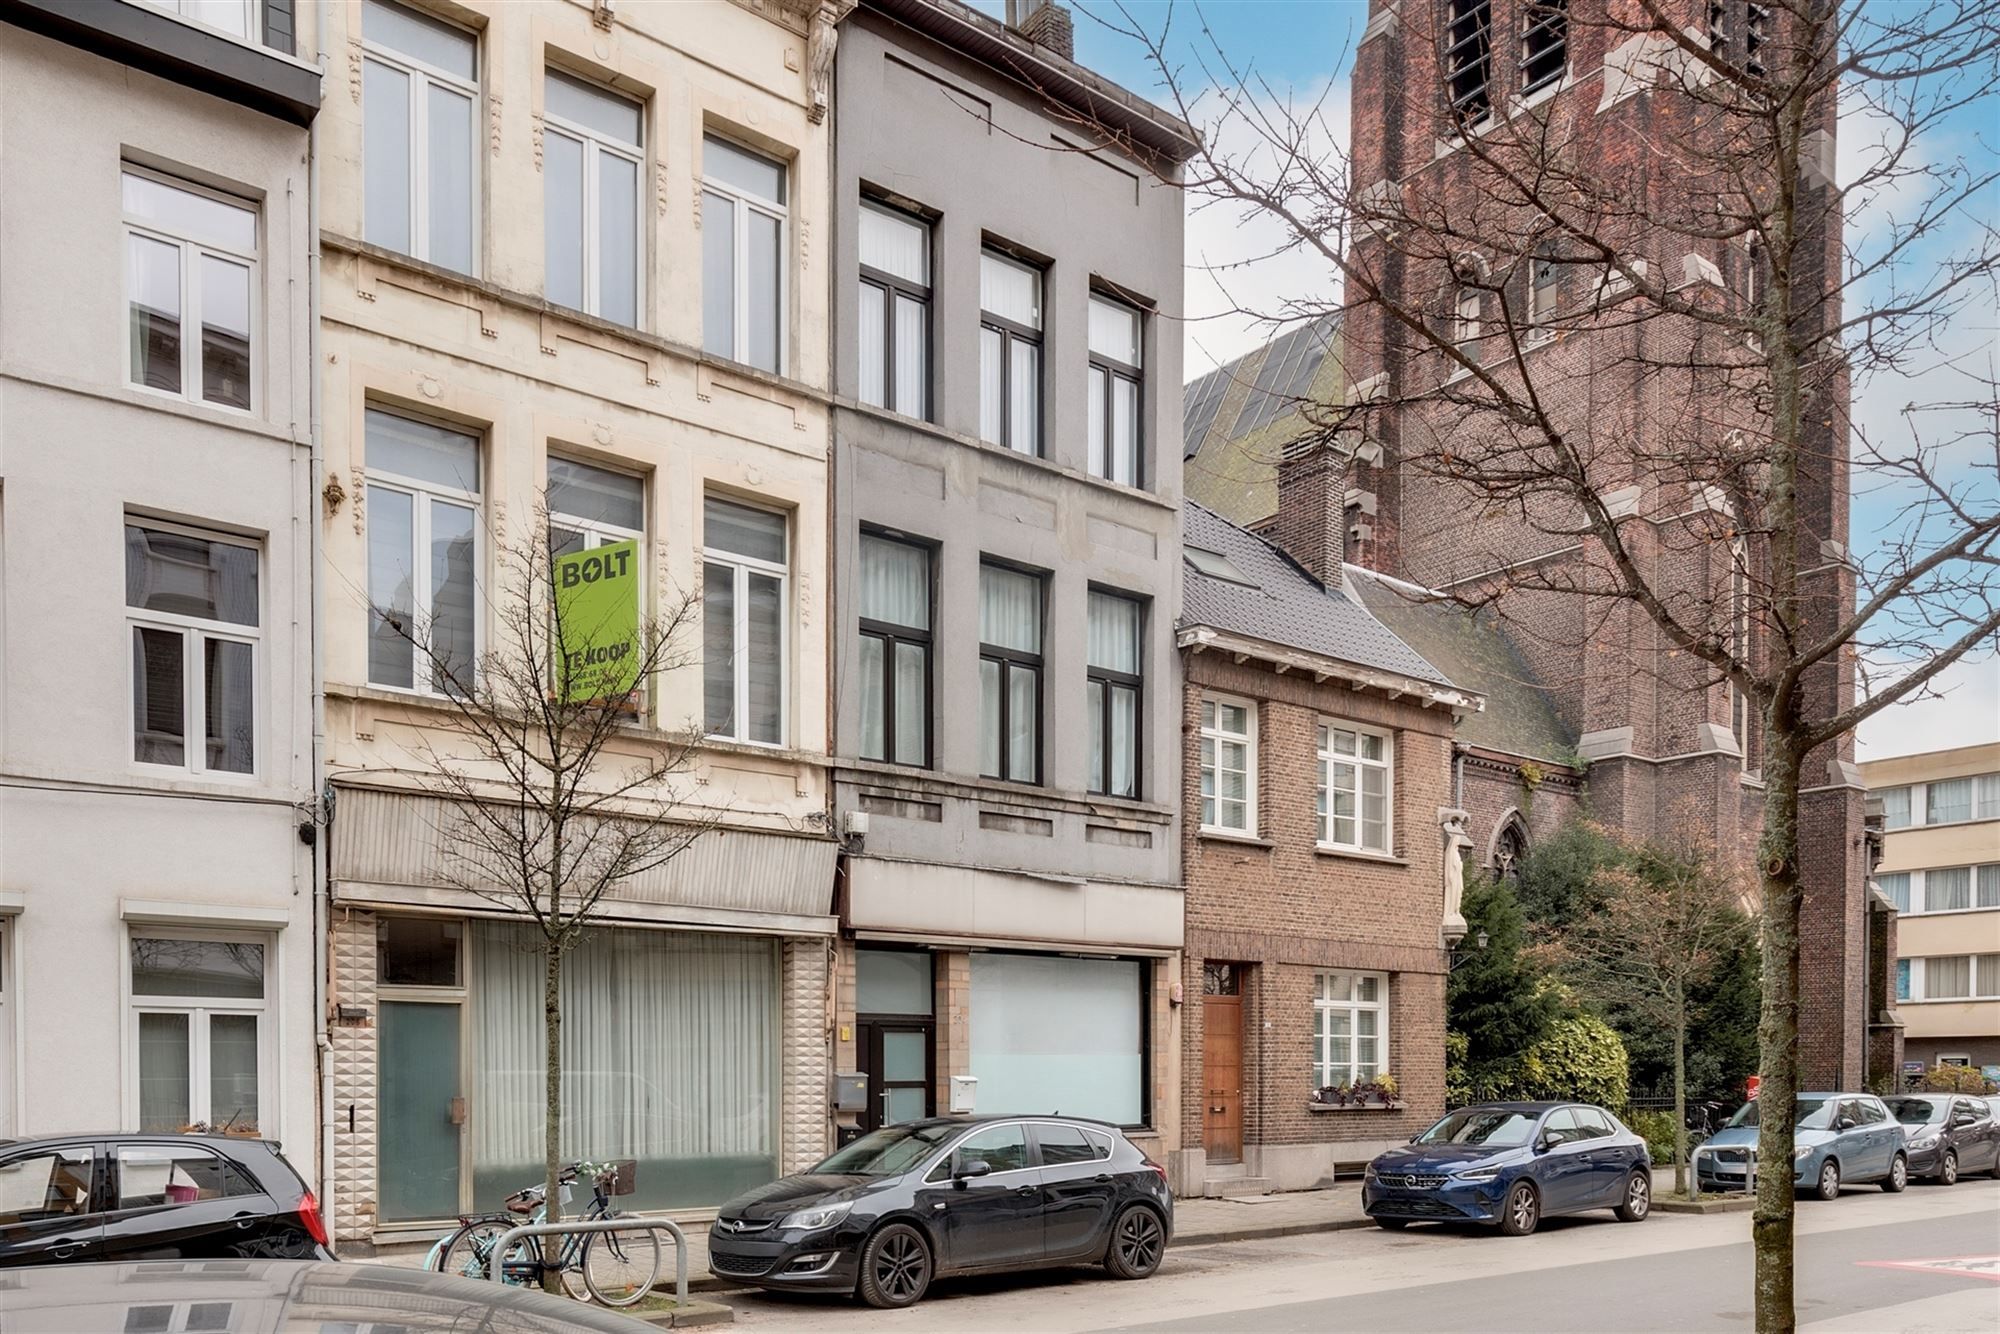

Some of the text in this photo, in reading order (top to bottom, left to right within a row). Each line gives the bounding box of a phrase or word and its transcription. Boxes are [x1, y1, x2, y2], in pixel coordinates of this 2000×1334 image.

[562, 549, 631, 588] BOLT
[565, 641, 631, 668] TE KOOP
